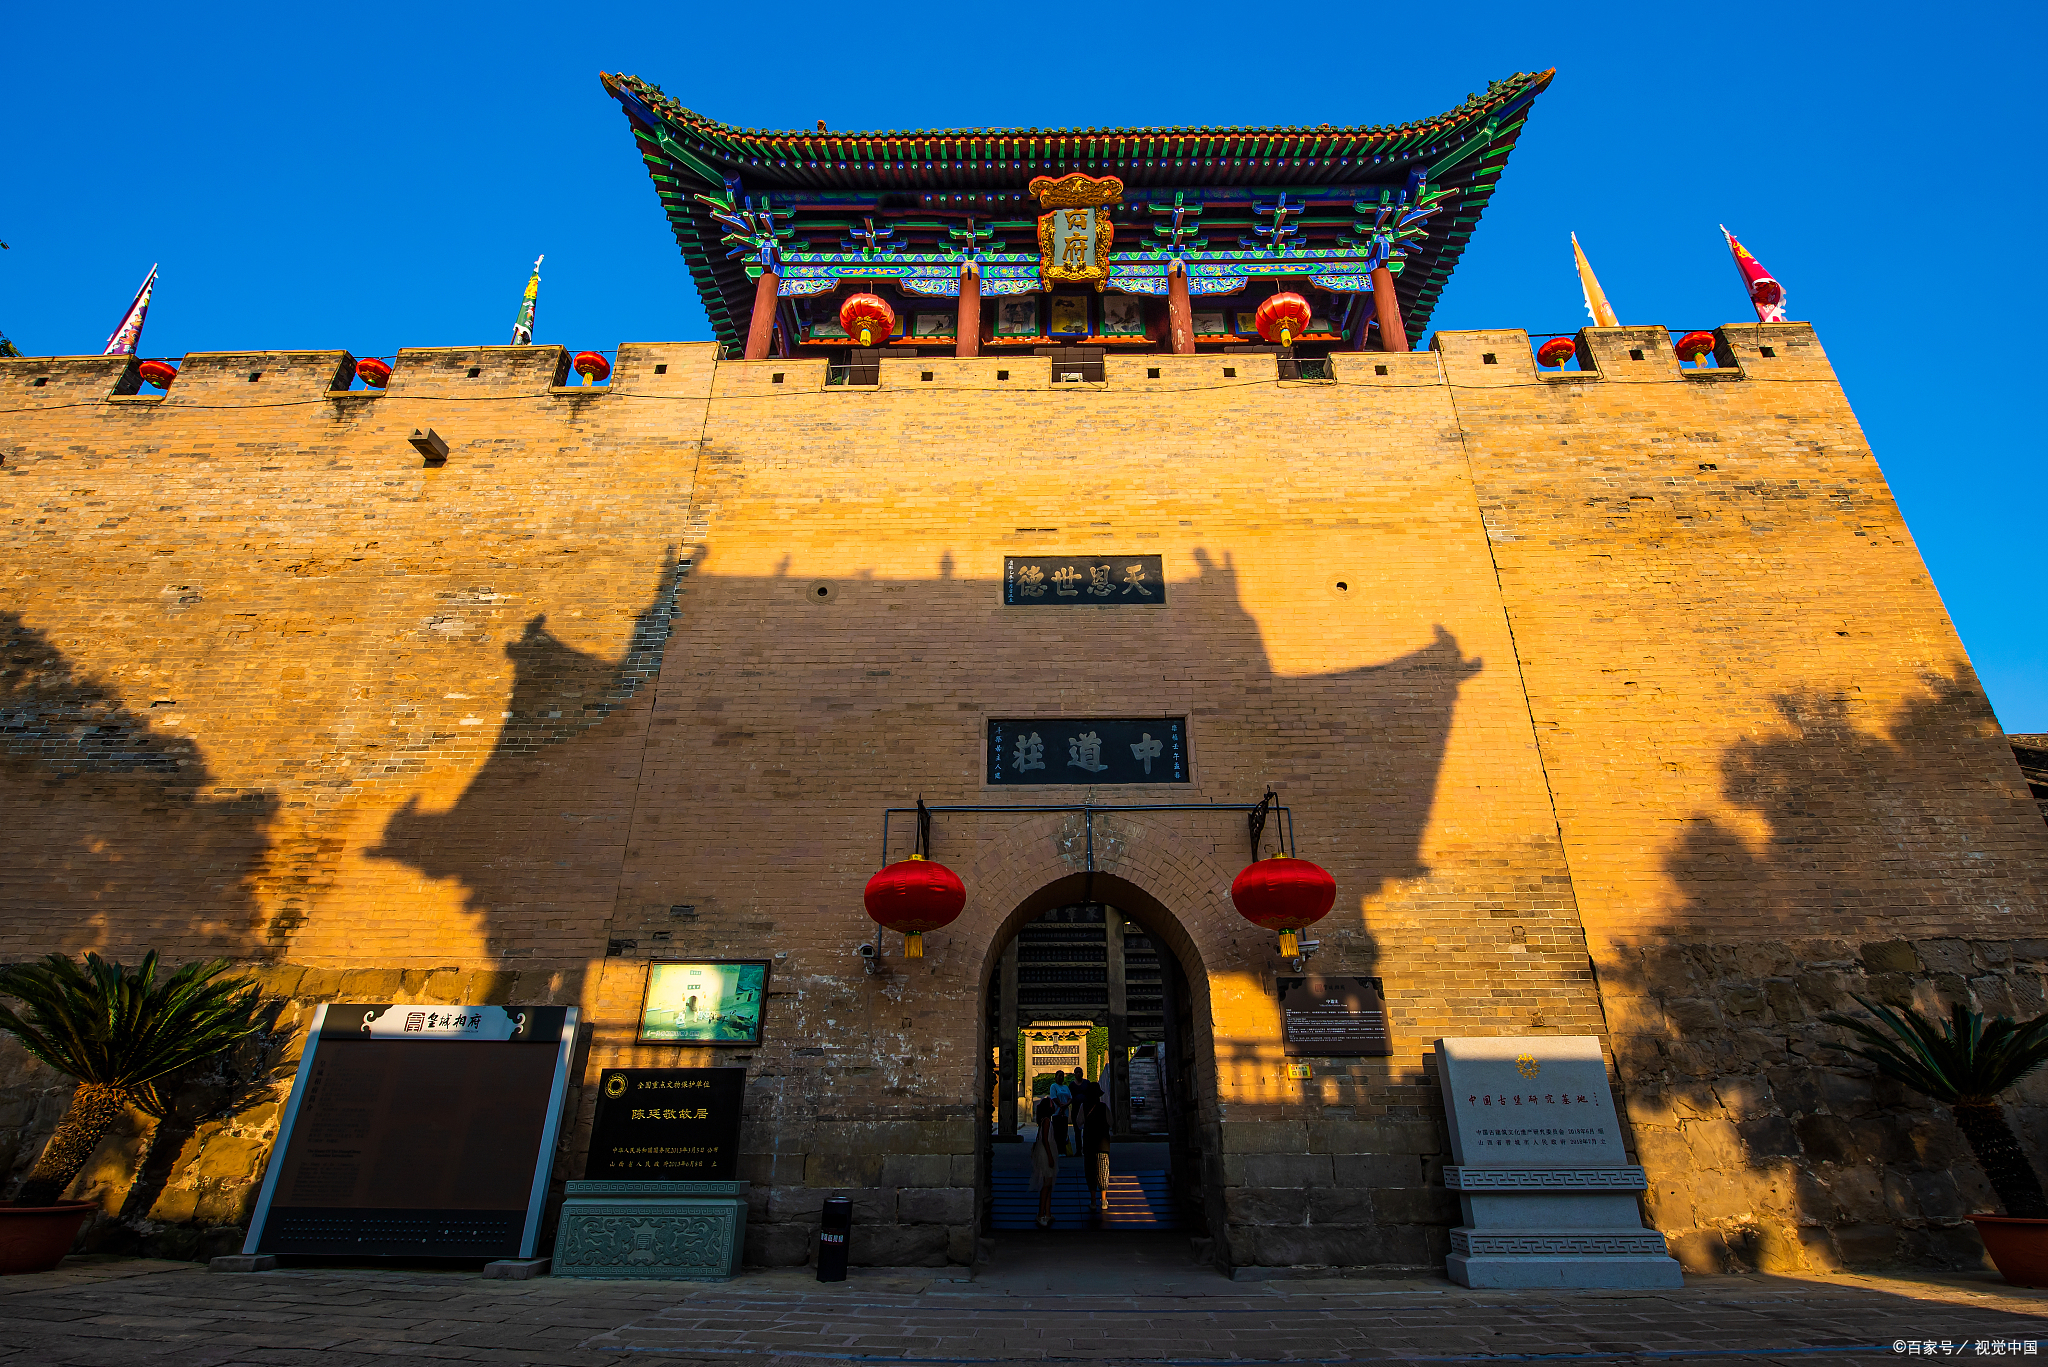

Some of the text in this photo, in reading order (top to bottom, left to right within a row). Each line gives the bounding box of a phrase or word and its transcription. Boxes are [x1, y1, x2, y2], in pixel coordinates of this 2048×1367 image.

[1016, 564, 1152, 597] 天恩世德
[428, 1012, 482, 1029] 皇城相府
[637, 1080, 711, 1090] 全国重点文物保护单位
[1468, 1094, 1588, 1106] 中国古堡研究基地
[631, 1108, 709, 1120] 陈廷敬故居
